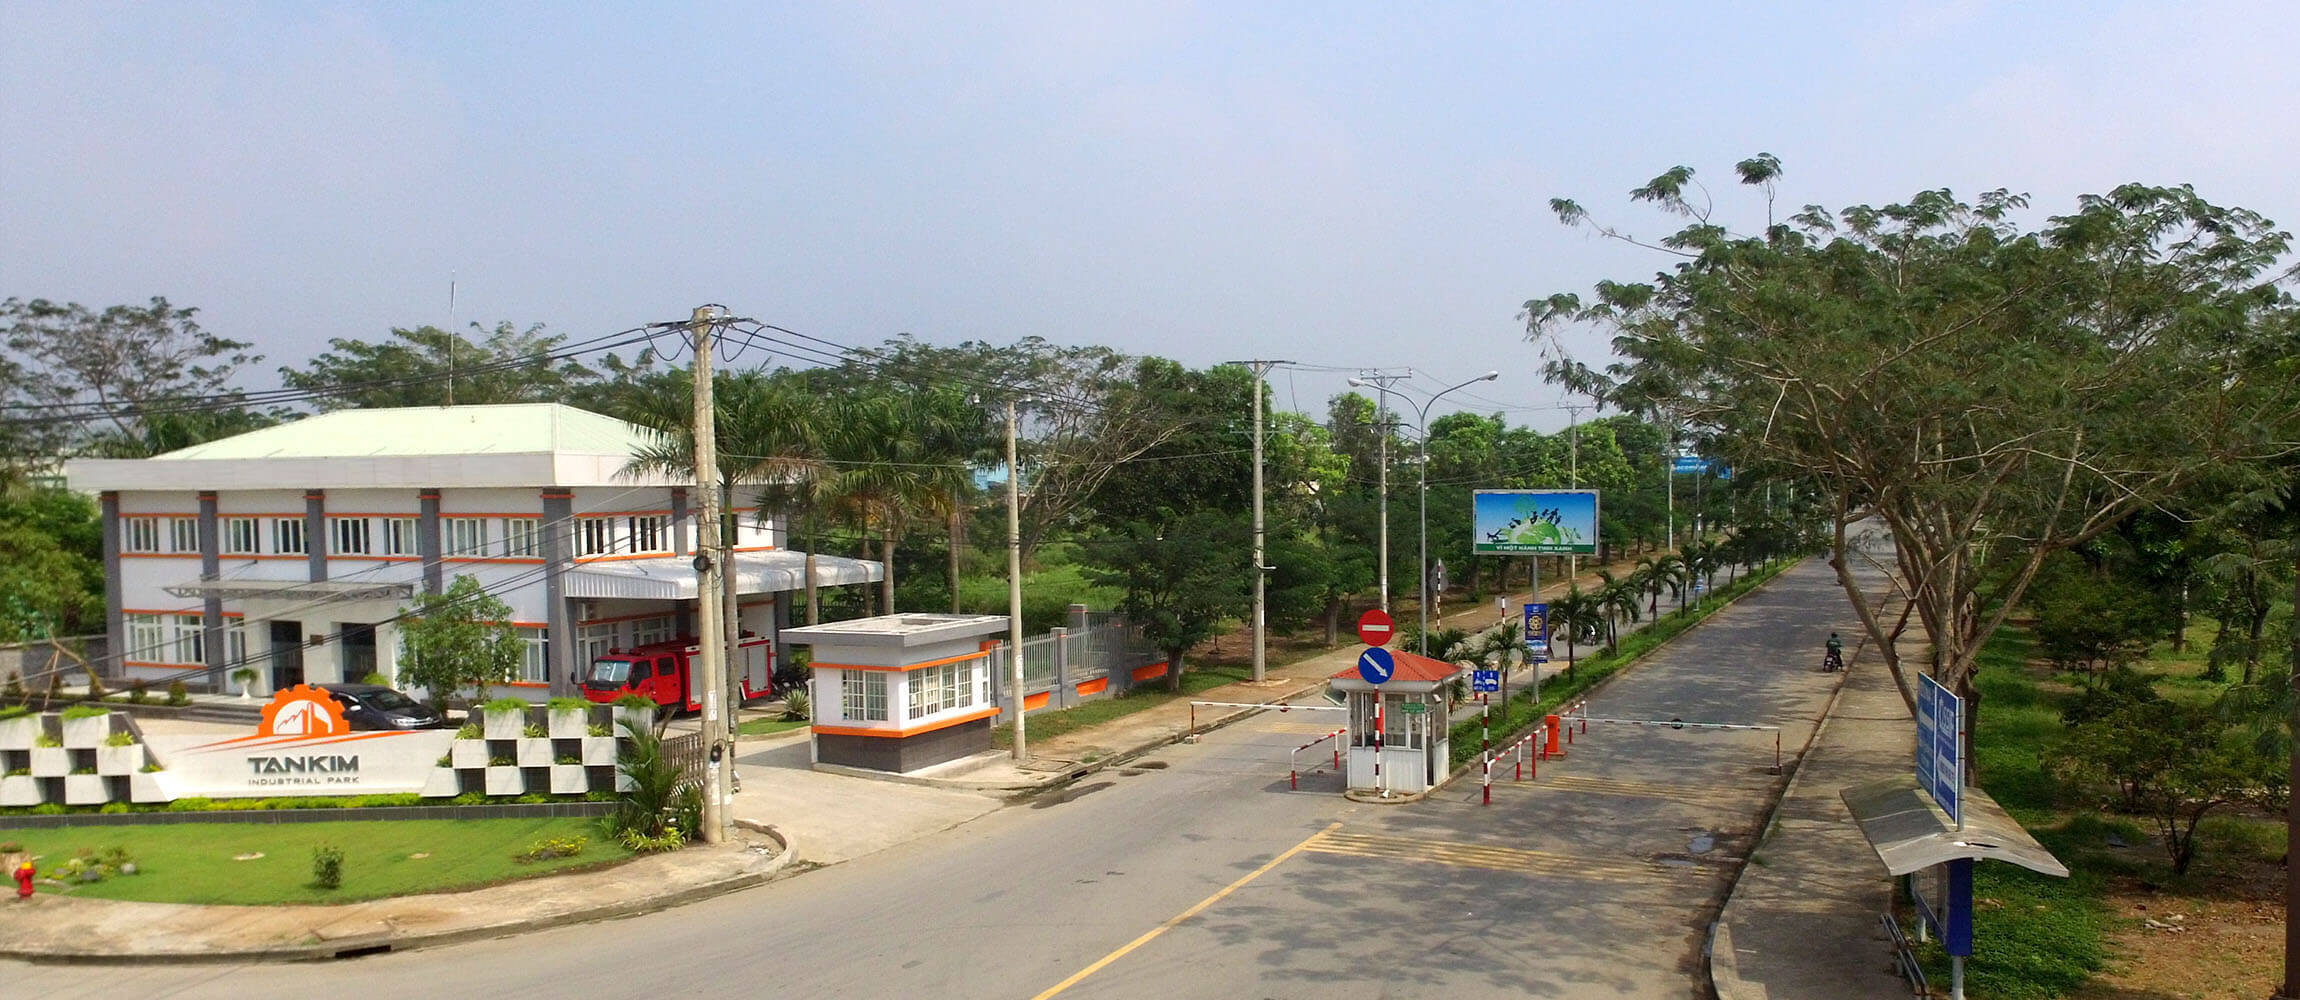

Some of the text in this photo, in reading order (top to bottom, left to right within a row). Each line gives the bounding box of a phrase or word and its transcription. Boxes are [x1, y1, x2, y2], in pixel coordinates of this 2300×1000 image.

[248, 755, 359, 773] TANKIM
[248, 776, 359, 786] INDUSTRIAL PARK
